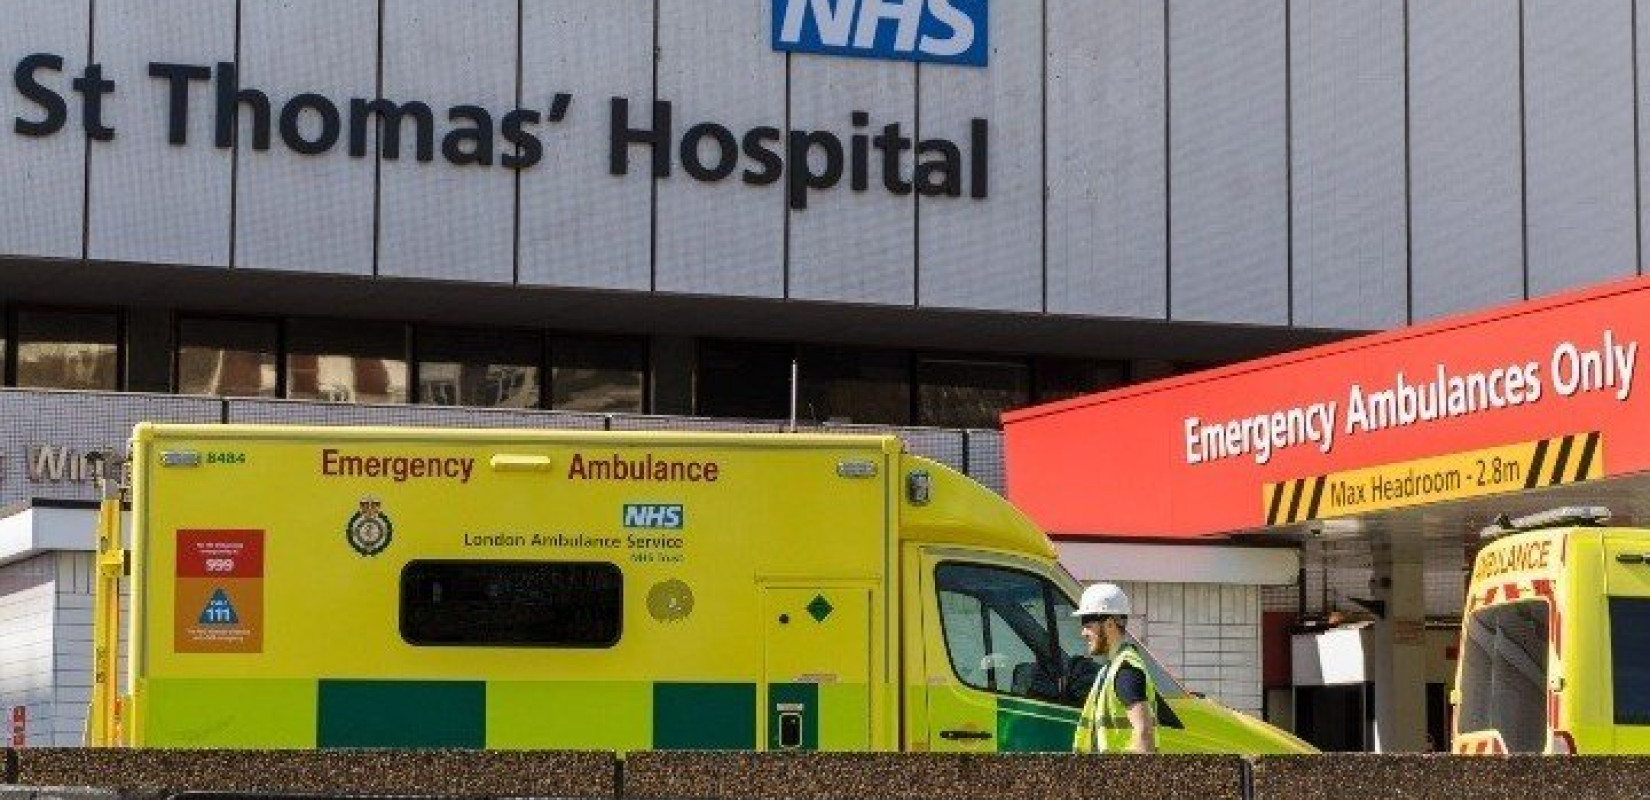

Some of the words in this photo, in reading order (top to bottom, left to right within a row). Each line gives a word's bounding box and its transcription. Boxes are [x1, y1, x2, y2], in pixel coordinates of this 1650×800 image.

[779, 0, 975, 56] NHS
[14, 53, 115, 141] St
[610, 97, 988, 209] Hospital
[1185, 400, 1337, 464] Emergency
[1345, 361, 1541, 434] Ambulances
[1550, 330, 1638, 400] Only
[206, 452, 246, 464] 8484
[321, 449, 475, 482] Emergency
[567, 454, 719, 482] Ambulance
[1330, 483, 1366, 507] Max
[1371, 467, 1461, 502] Headroom
[1476, 455, 1520, 487] 2.8m
[626, 505, 681, 527] NHS
[464, 533, 525, 547] London
[531, 533, 622, 549] Ambulance
[627, 533, 684, 549] Service
[205, 558, 235, 572] 999
[206, 607, 230, 622] 111
